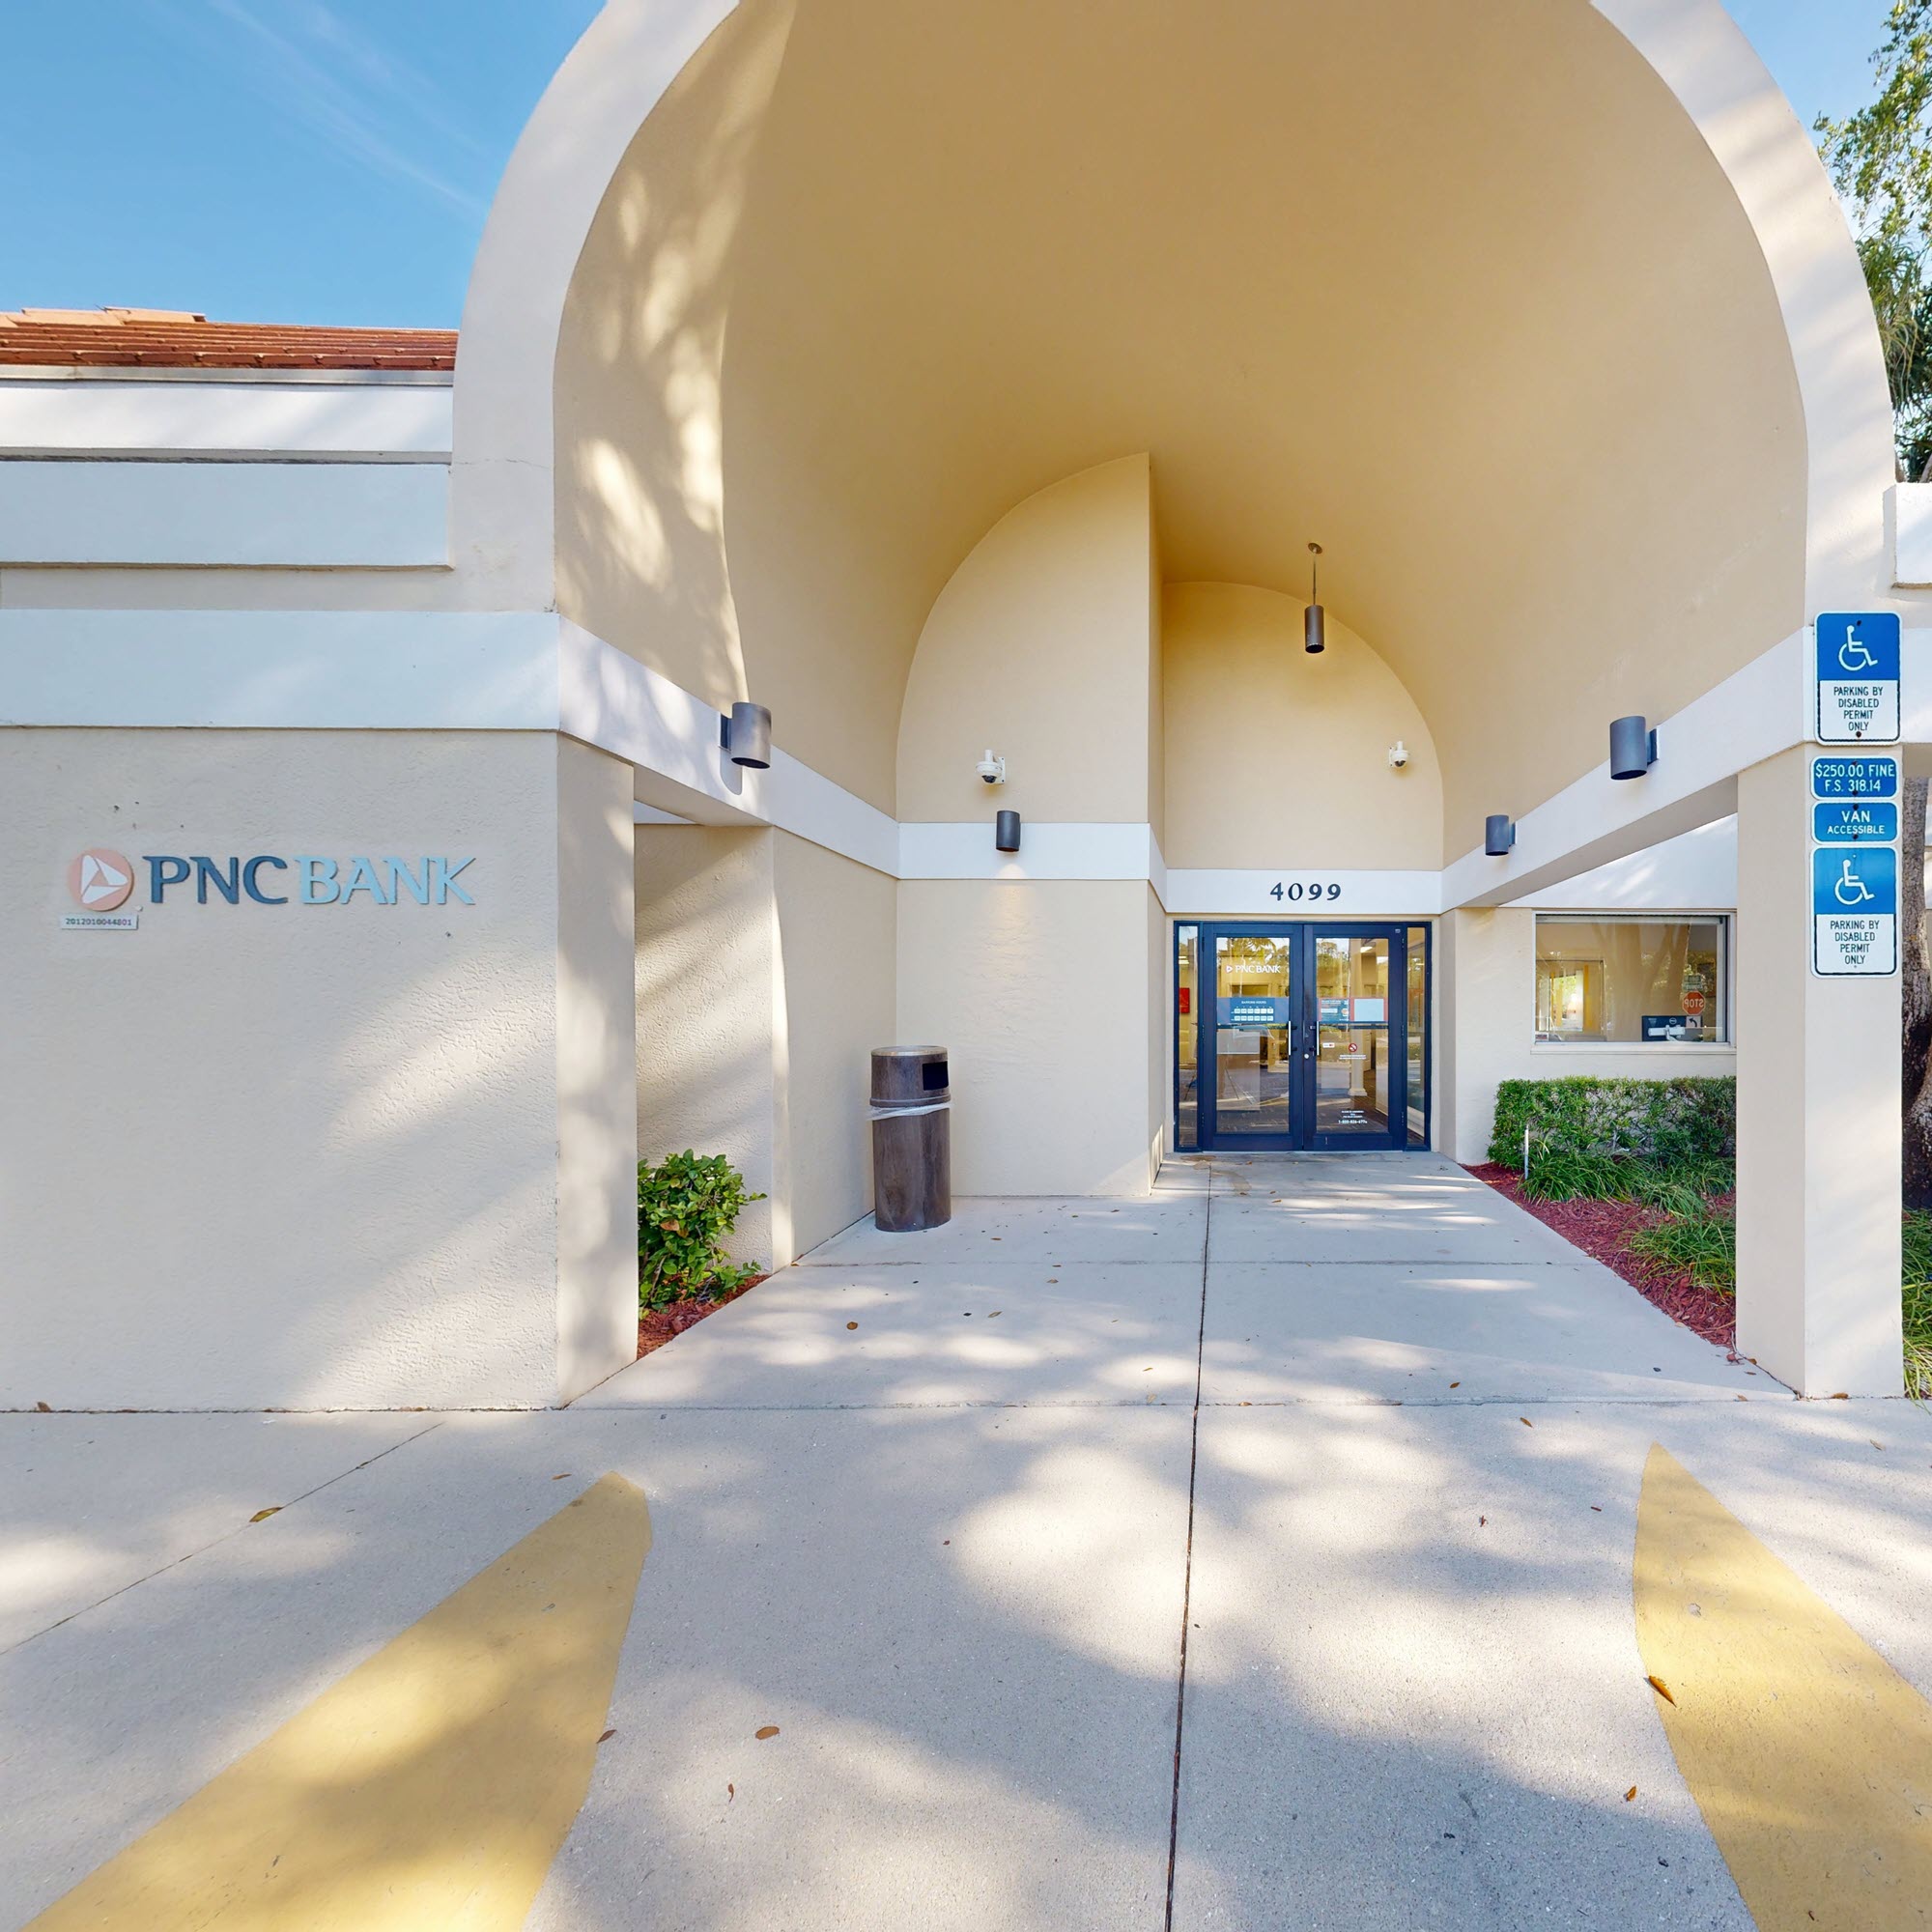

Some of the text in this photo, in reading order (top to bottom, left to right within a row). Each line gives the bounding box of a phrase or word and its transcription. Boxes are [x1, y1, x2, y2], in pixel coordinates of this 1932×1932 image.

[1833, 687, 1884, 696] PARKING BY
[1838, 698, 1880, 708] DISABLED
[1843, 710, 1874, 720] PERMIT
[1848, 722, 1869, 731] ONLY
[1815, 763, 1895, 779] $250.00 FINE
[1824, 780, 1882, 792] F.S. 318.14
[1841, 810, 1870, 823] VAN
[1827, 825, 1886, 835] ACCESSIBLE
[1269, 882, 1342, 901] 4099
[1830, 920, 1880, 930] PARKING BY
[1834, 931, 1876, 942] DISABLED
[1839, 943, 1870, 953] PERMIT
[1844, 954, 1865, 965] ONLY
